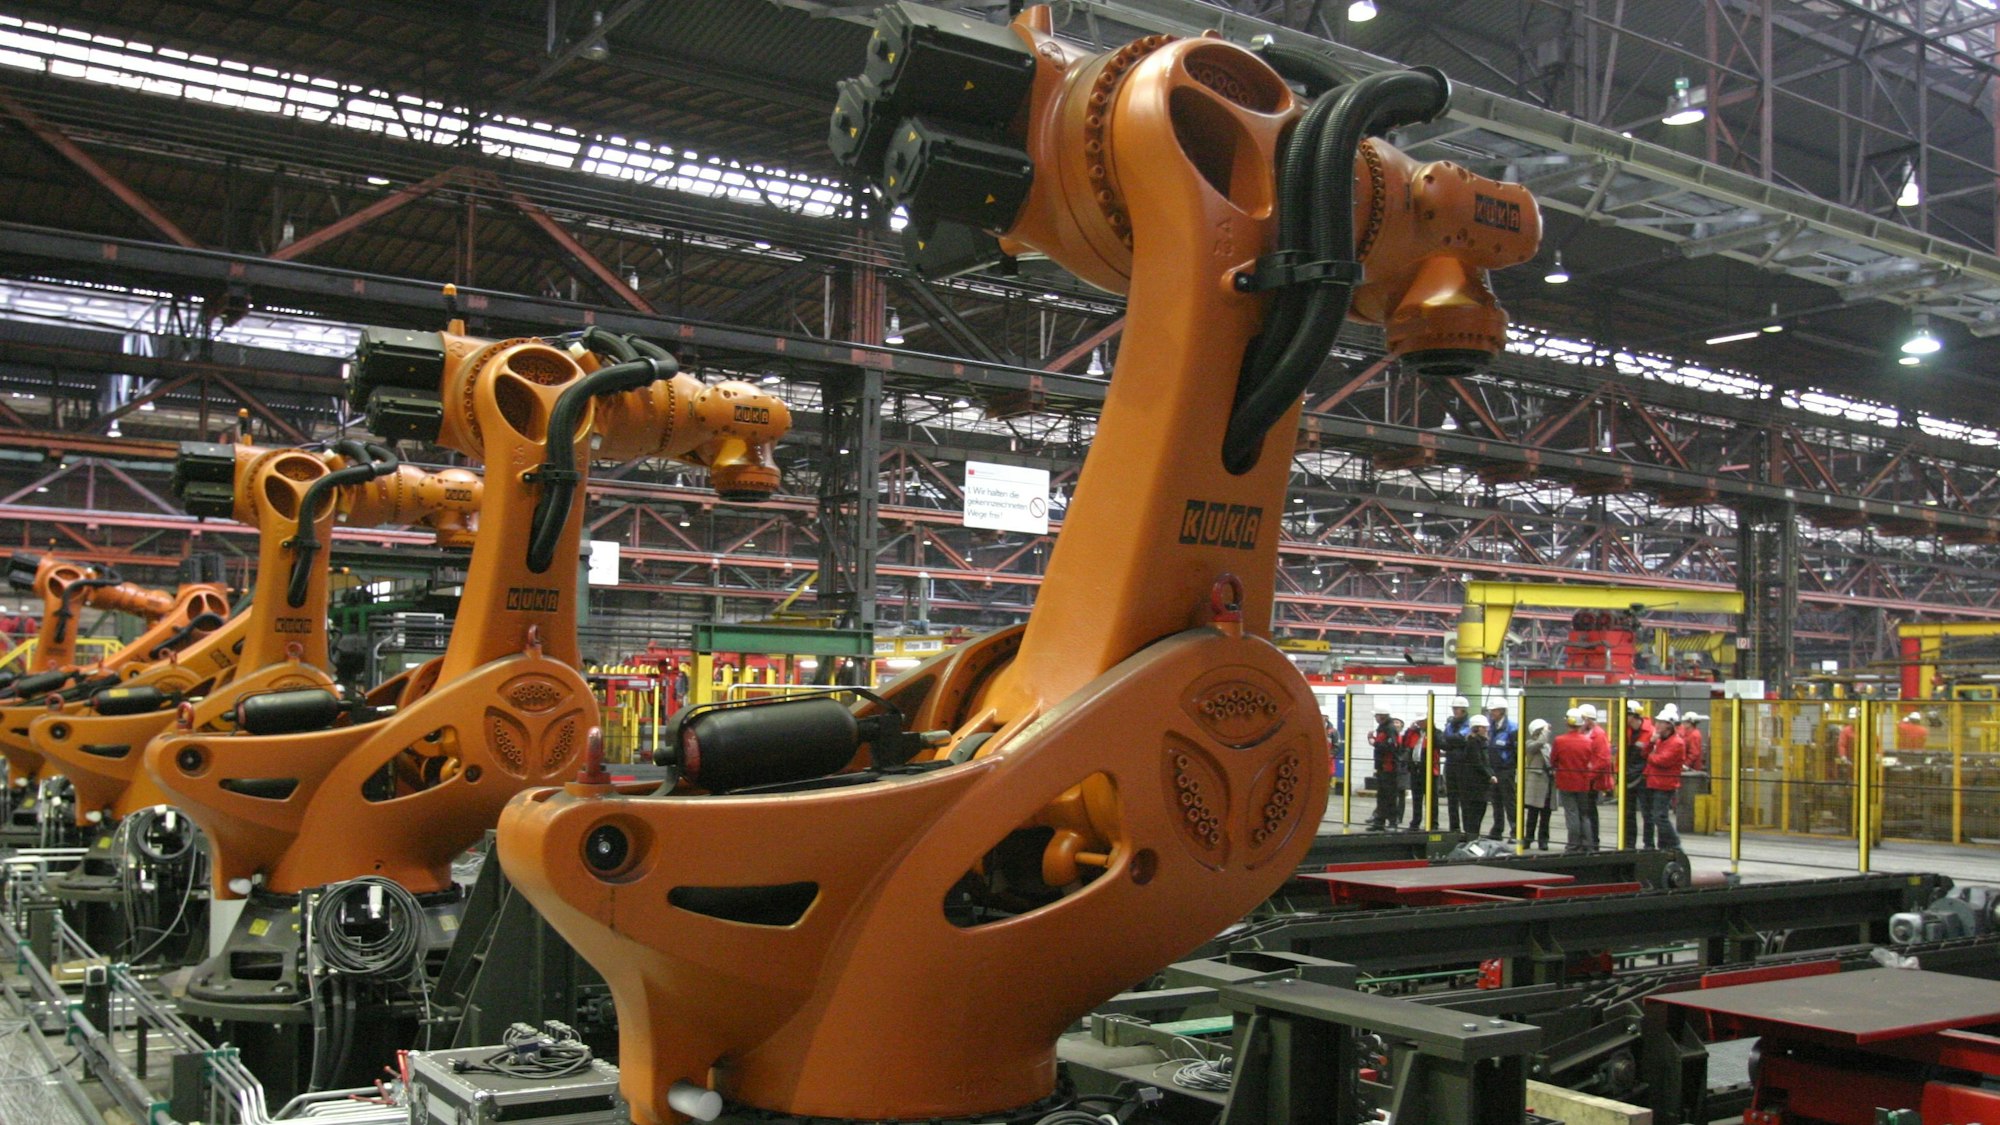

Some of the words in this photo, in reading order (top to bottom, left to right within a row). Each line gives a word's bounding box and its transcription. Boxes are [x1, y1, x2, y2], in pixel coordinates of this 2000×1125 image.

[1474, 194, 1521, 233] KUKA
[734, 405, 770, 425] KUKA
[1179, 499, 1263, 550] KUKA
[507, 587, 560, 612] KUKA
